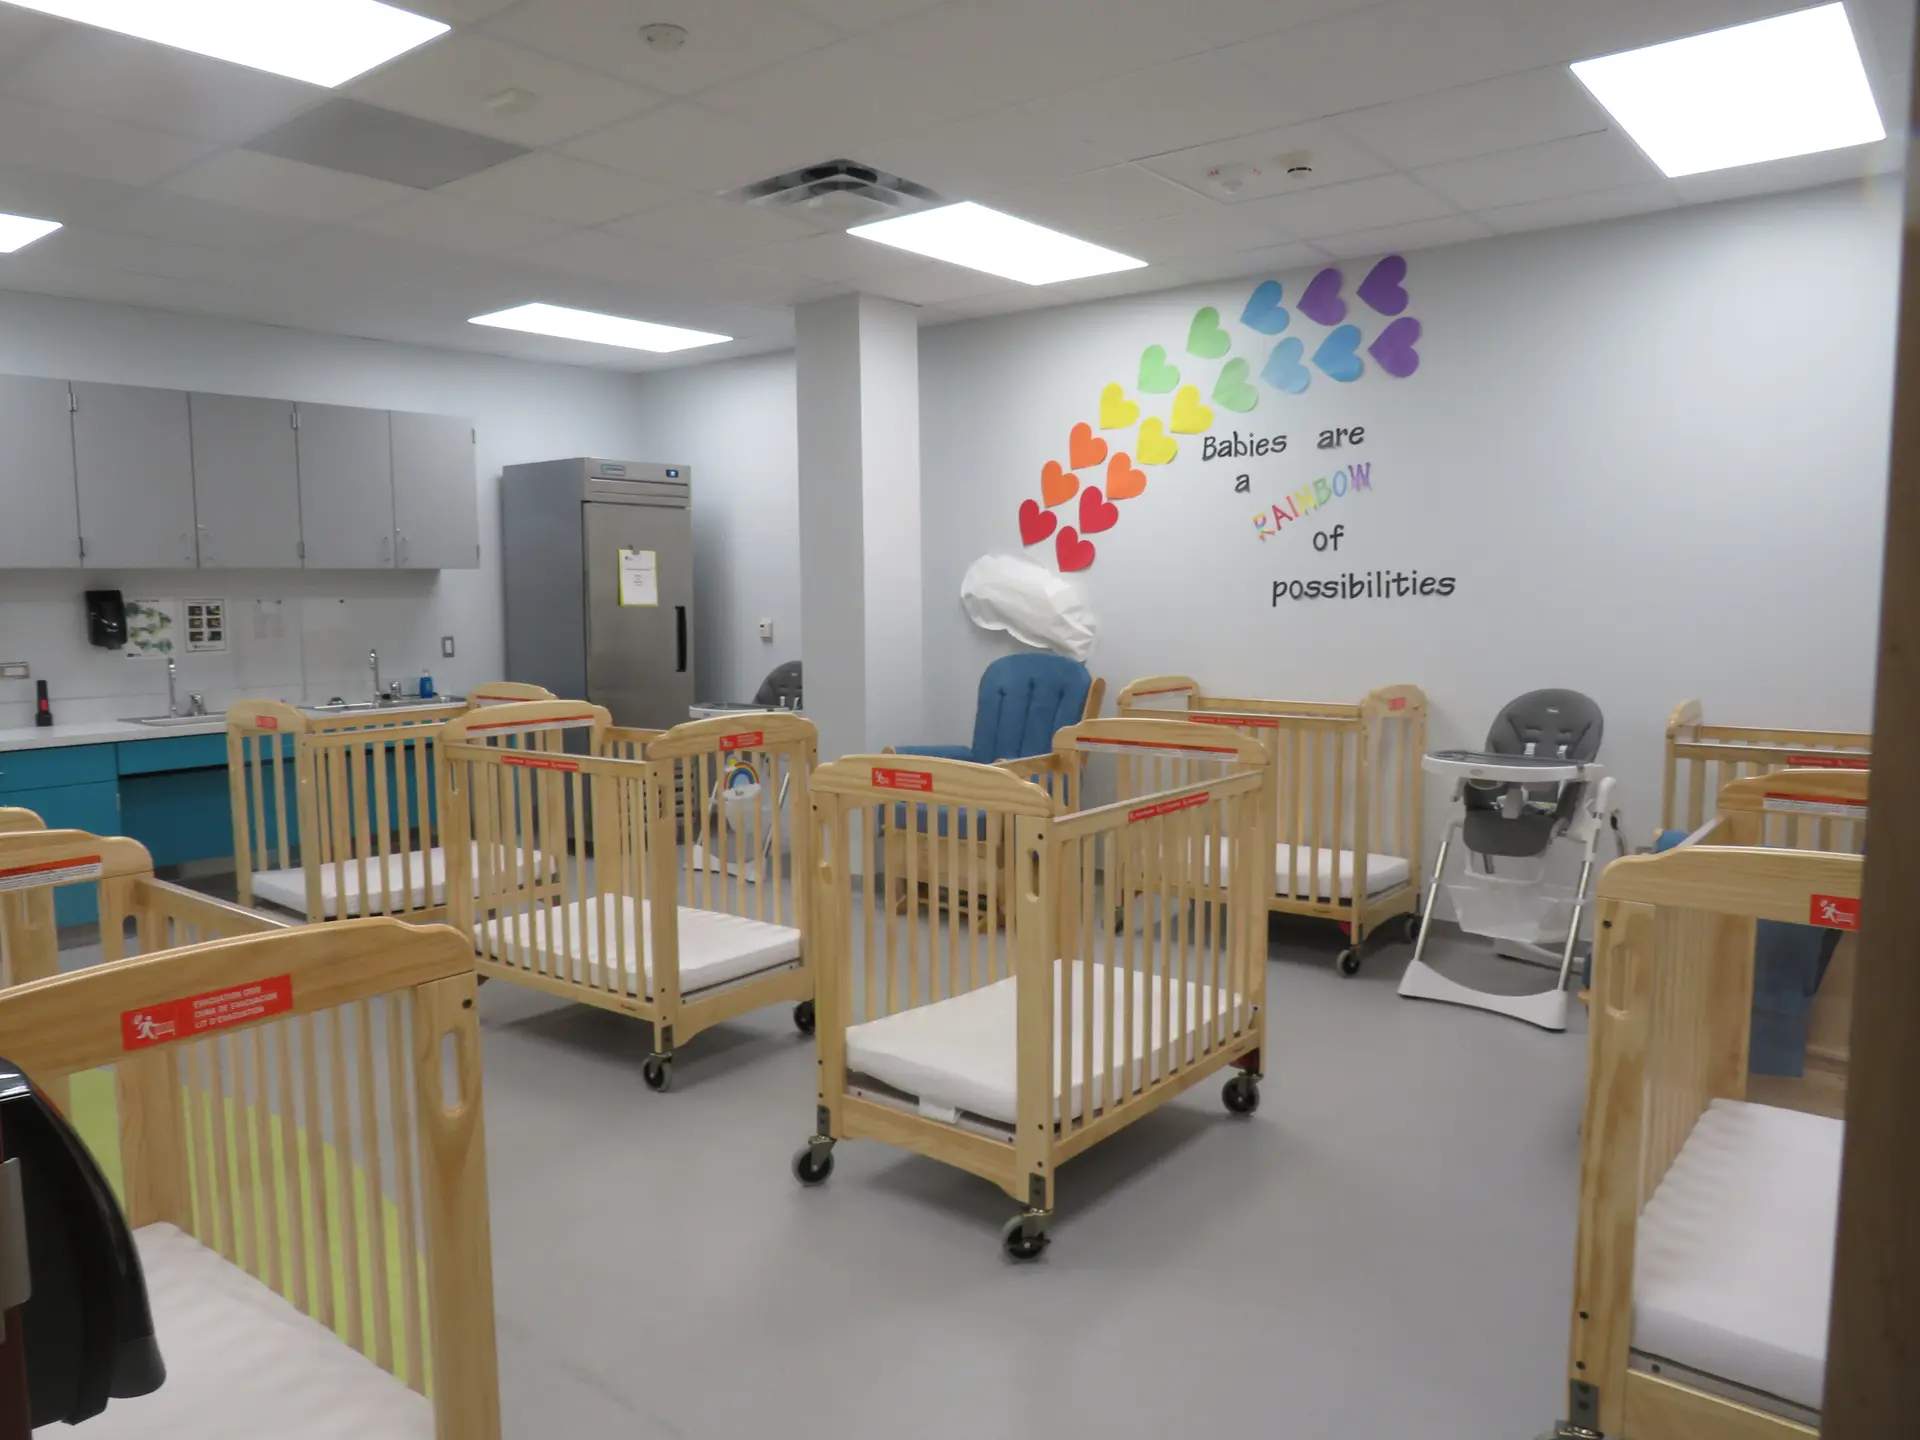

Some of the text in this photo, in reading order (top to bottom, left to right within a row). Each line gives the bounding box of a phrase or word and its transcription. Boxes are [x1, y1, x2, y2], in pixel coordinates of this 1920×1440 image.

[1202, 426, 1365, 461] Babies are
[1234, 462, 1372, 541] a RAINBOW
[1313, 524, 1344, 551] of
[1272, 570, 1456, 607] possibilities
